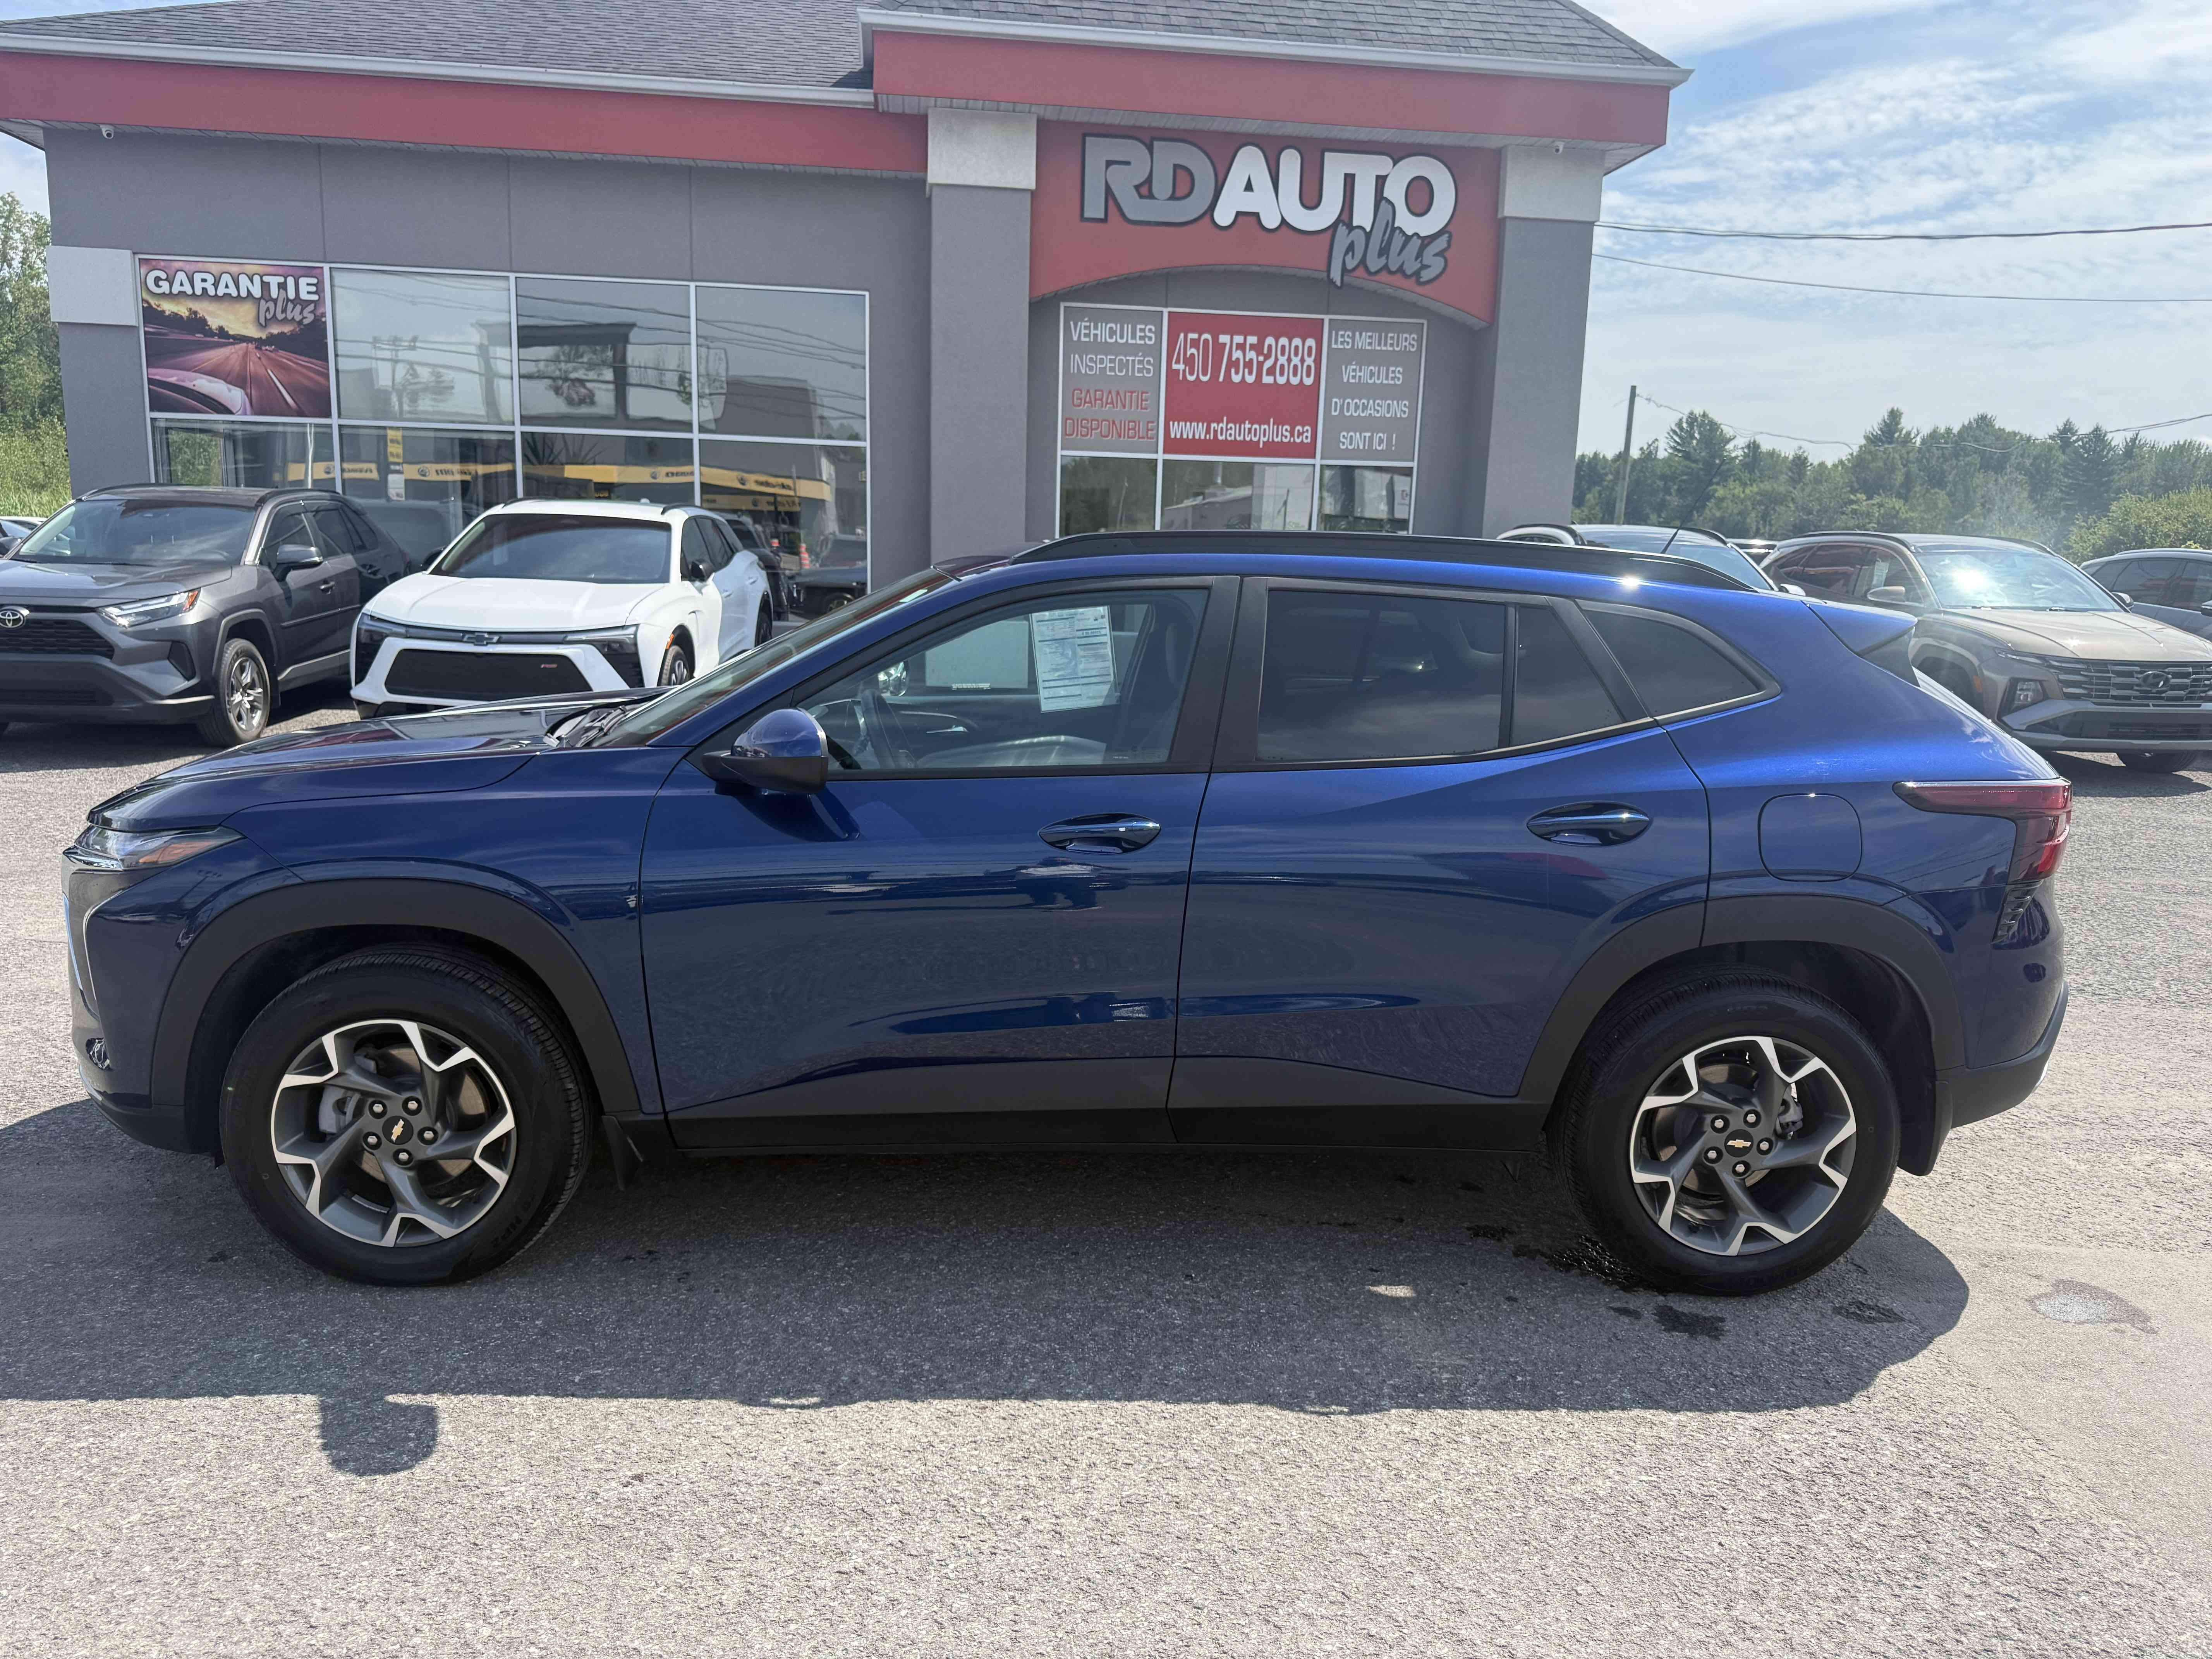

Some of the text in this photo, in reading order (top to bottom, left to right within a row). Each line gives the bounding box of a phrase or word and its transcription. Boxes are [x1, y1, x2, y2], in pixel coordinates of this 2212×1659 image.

[1213, 144, 1457, 237] AUTO
[1329, 198, 1452, 288] plus
[146, 269, 319, 301] GARANTIE
[259, 289, 315, 327] plus
[1070, 317, 1155, 345] VÉHICULES
[1331, 330, 1417, 352] LES MEILLEURS
[1070, 352, 1154, 377] INSPECTÉS
[1171, 333, 1316, 386] 450 755-2888
[1342, 360, 1403, 384] VÉHICULES
[1072, 388, 1151, 412] GARANTIE
[1065, 417, 1156, 441] DISPONIBLE
[1170, 416, 1311, 448] www.rdautoplus.ca
[1340, 431, 1371, 450] SONT
[1372, 432, 1387, 450] ICI
